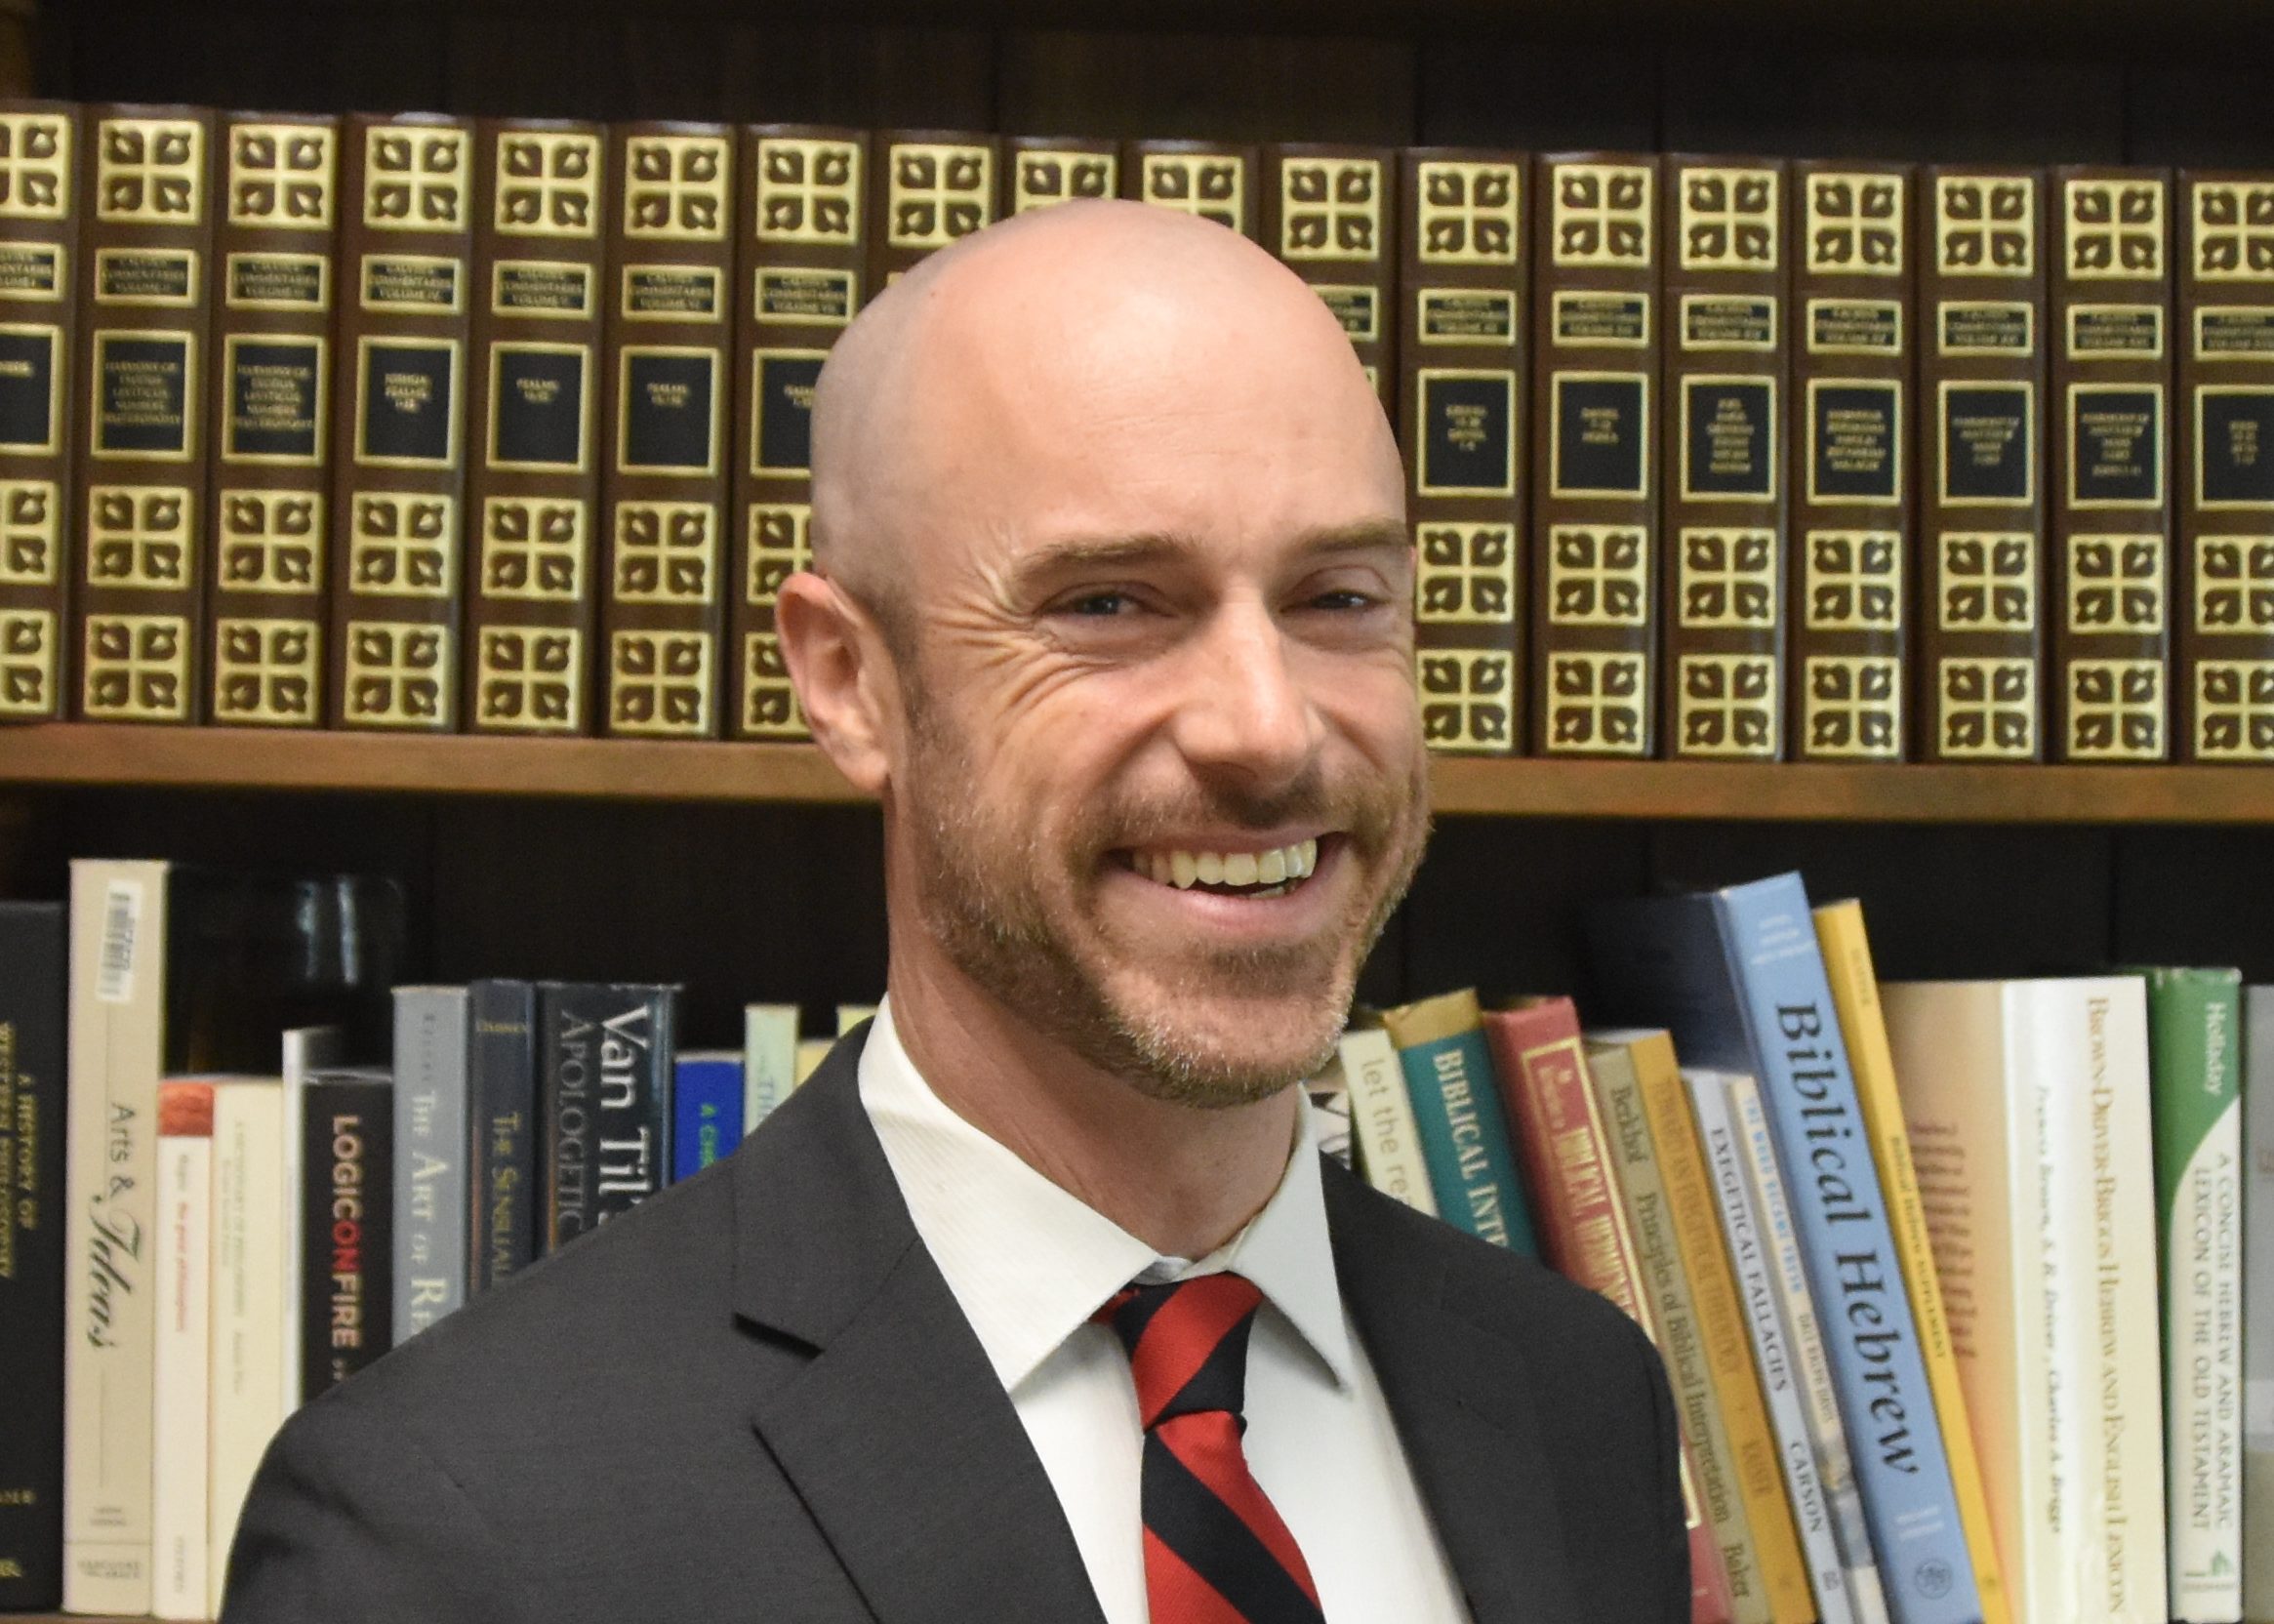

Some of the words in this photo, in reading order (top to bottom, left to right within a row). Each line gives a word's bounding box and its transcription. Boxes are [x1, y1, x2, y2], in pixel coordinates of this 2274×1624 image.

[600, 1004, 651, 1109] Van
[1361, 1057, 1391, 1097] let
[2204, 1000, 2228, 1098] Holladay
[110, 1102, 137, 1162] Arts
[1372, 1106, 1401, 1157] the
[1432, 1048, 1489, 1180] BIBLICAL
[1610, 1086, 1648, 1164] Berkhof
[109, 1175, 137, 1198] &
[411, 1152, 450, 1222] ART
[1387, 1165, 1412, 1206] re
[2219, 1153, 2234, 1169] A
[1636, 1191, 1679, 1290] Principles
[1774, 1002, 1872, 1224] Biblical
[1833, 1249, 1921, 1475] Hebrew
[2194, 1166, 2213, 1263] LEXICON
[2218, 1177, 2235, 1271] CONCISE
[1662, 1293, 1684, 1312] of
[2193, 1271, 2213, 1300] OF
[1667, 1316, 1704, 1390] Biblical
[1710, 1126, 1757, 1261] EXEGETICAL
[1746, 1271, 1788, 1392] FALLACIES
[1788, 1441, 1824, 1534] CARSON
[2193, 1310, 2213, 1346] THE
[2217, 1281, 2235, 1366] HEBREW
[2102, 1364, 2122, 1412] AND
[2192, 1356, 2213, 1400] OLD
[2217, 1375, 2235, 1421] AND
[1685, 1392, 1733, 1525] Interpretation
[2191, 1409, 2213, 1533] TESTAMENT
[2215, 1429, 2235, 1532] ARAMAIC
[1722, 1543, 1752, 1599] Baker
